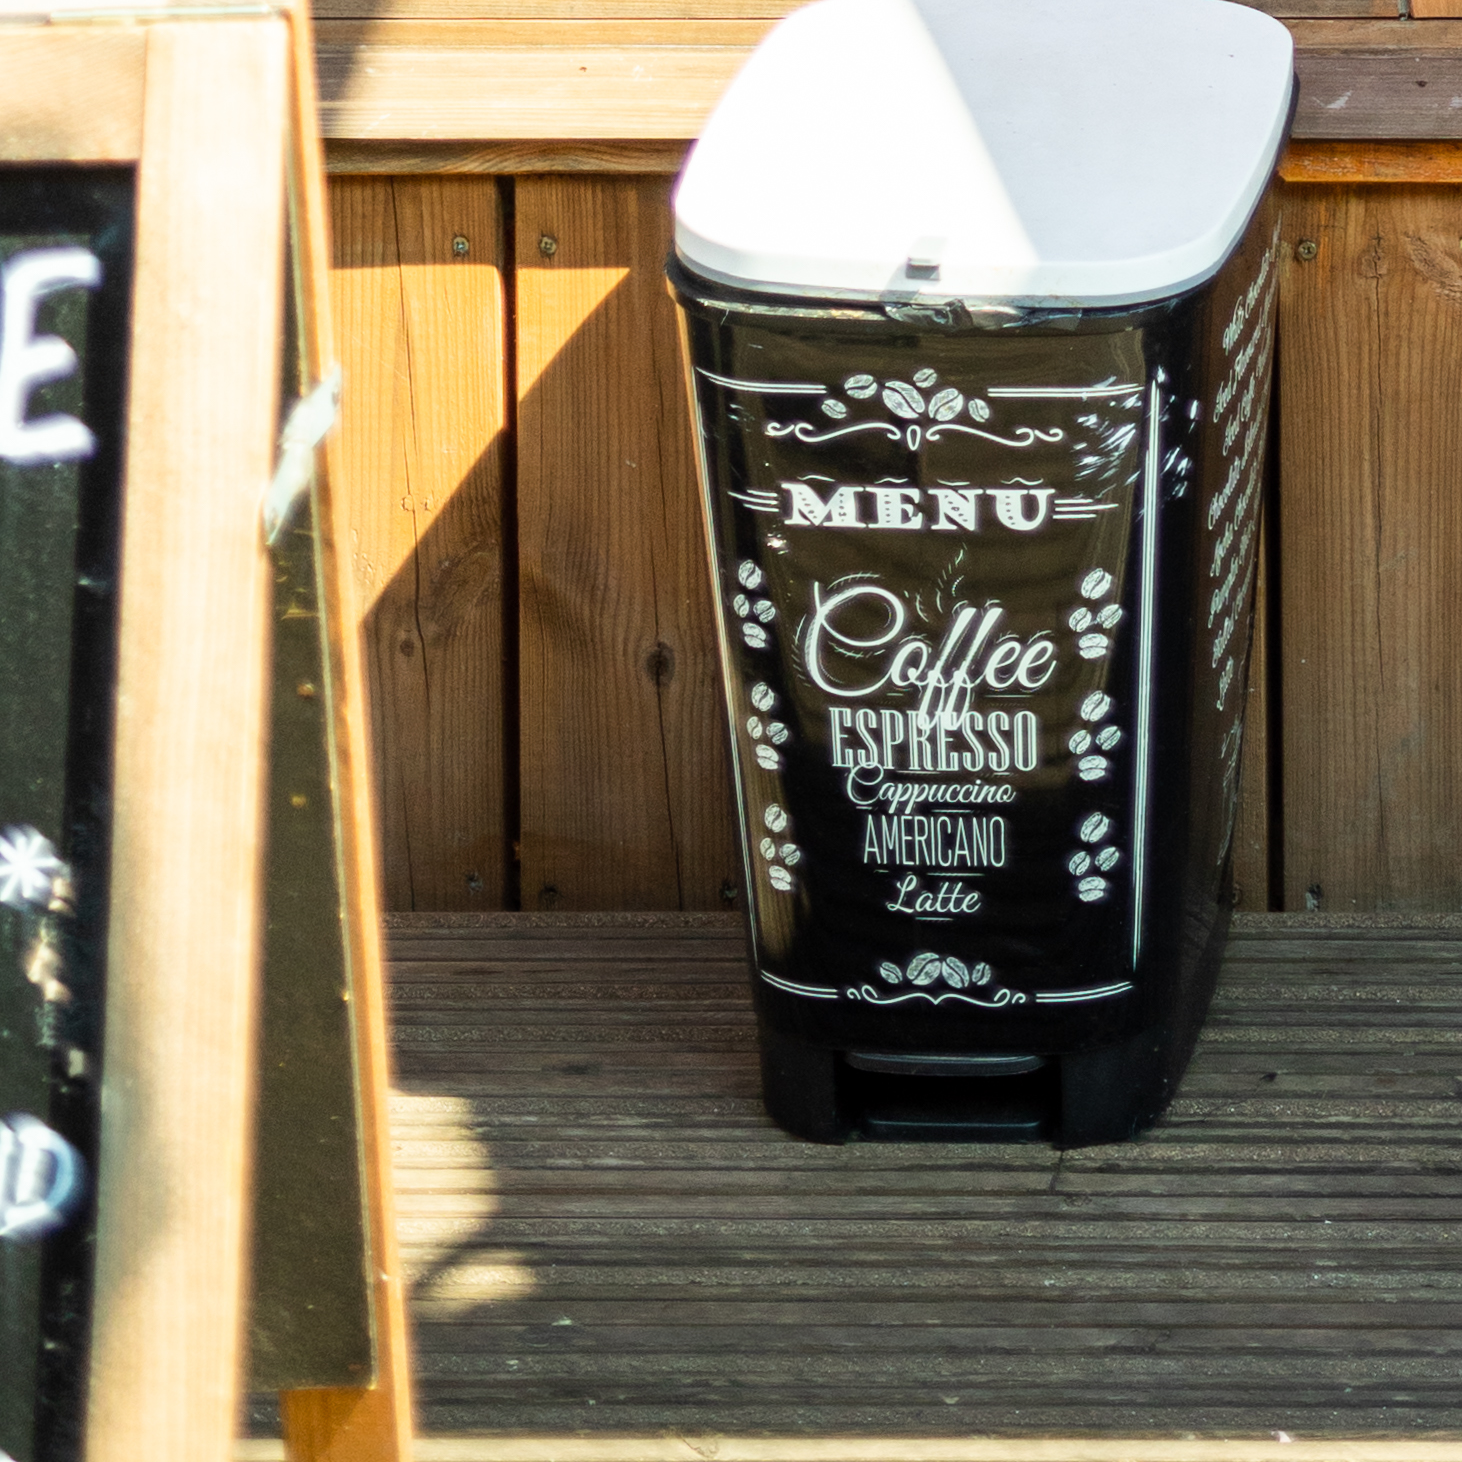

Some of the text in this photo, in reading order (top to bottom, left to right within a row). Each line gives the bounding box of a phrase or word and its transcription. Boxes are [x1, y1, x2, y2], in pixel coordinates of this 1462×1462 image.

[780, 480, 1057, 532] MENU
[803, 577, 1057, 732] Coffee
[828, 706, 1039, 774] ESPRESSO
[845, 761, 1016, 813] Cappuccino
[862, 814, 1007, 869] AMERICANO
[887, 874, 981, 915] Latte
